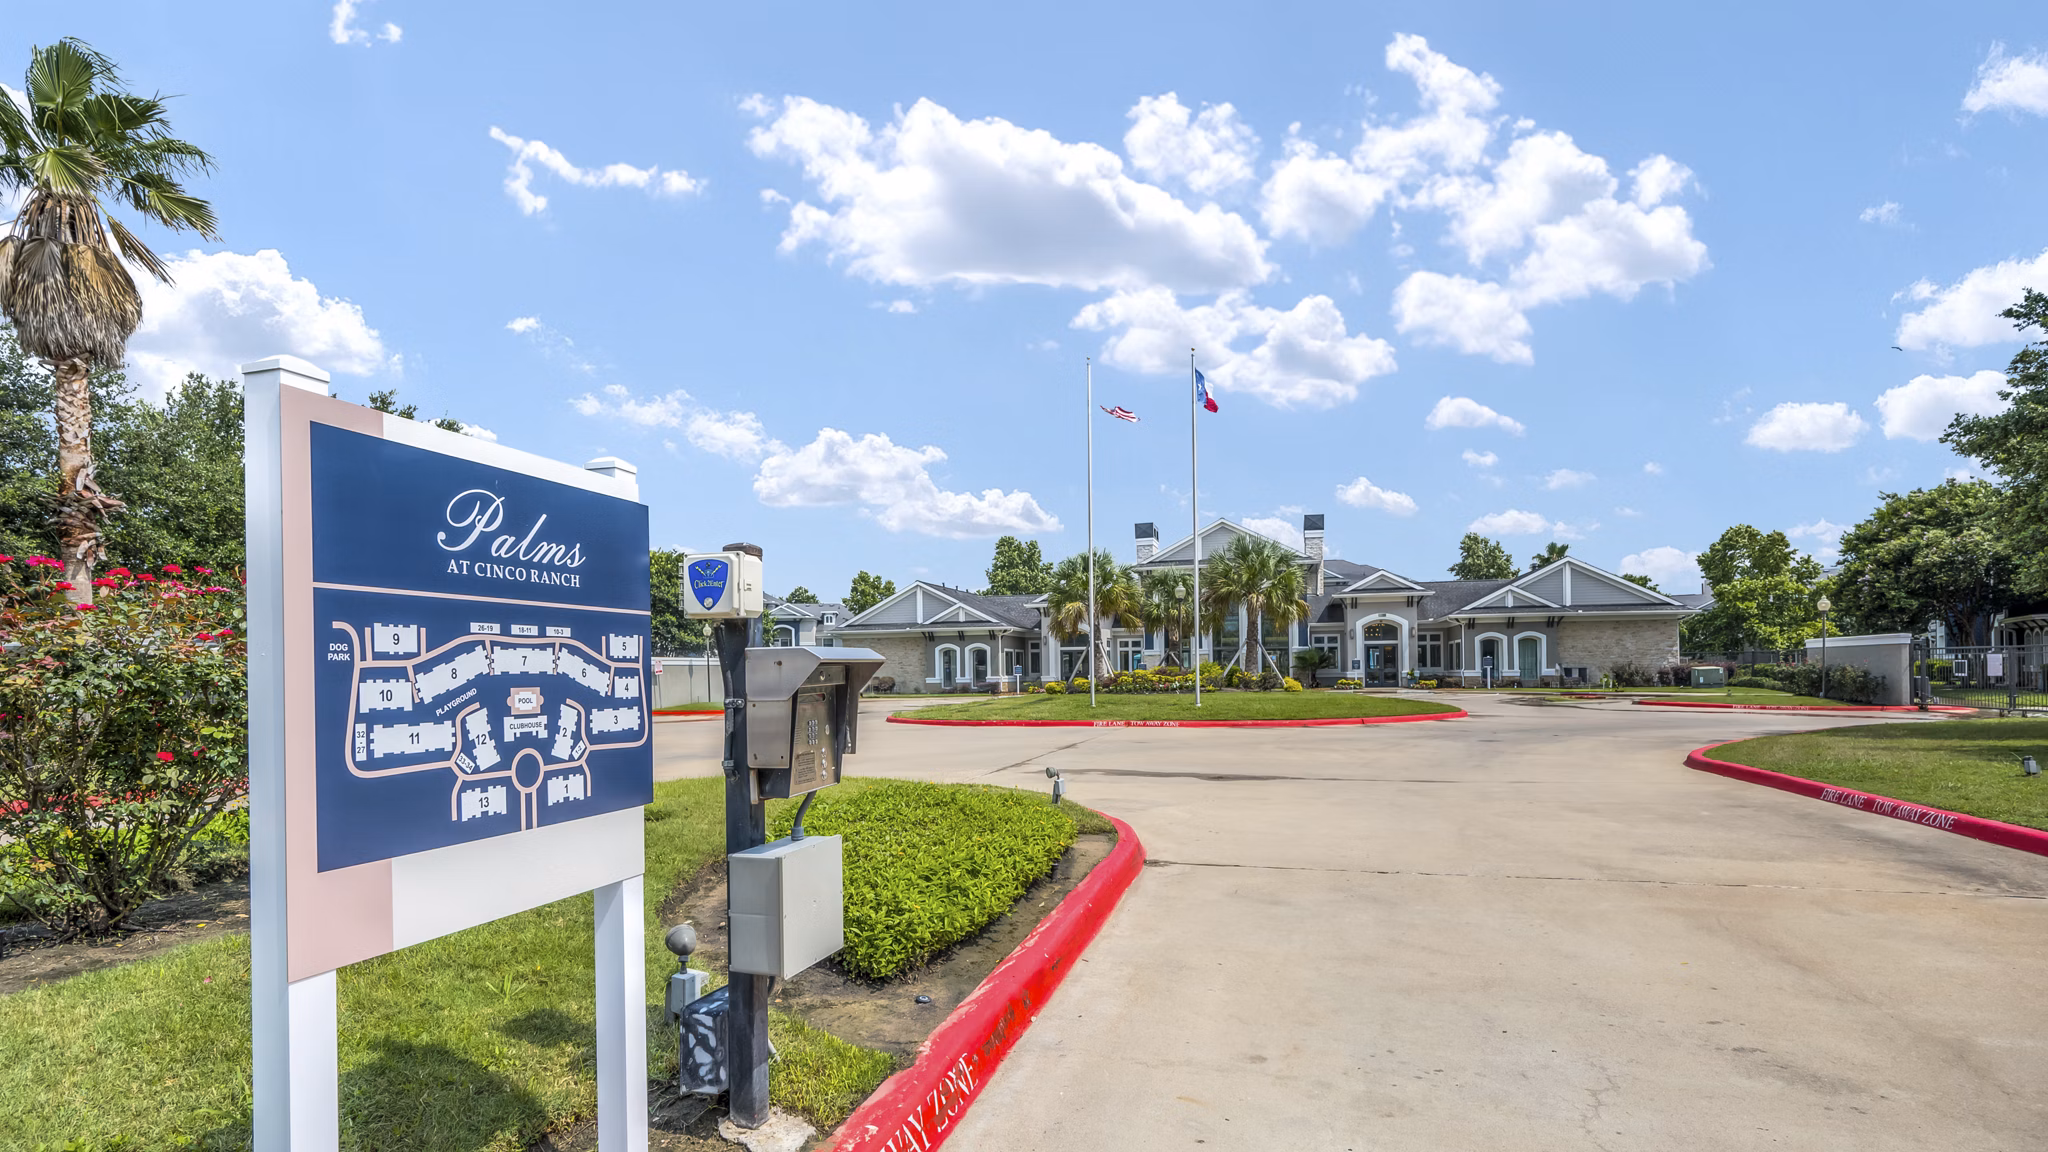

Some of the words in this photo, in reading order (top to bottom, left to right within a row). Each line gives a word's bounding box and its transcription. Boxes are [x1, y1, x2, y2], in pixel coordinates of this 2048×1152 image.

[437, 489, 586, 568] Palms
[447, 559, 470, 575] AT
[474, 562, 526, 581] CINCO
[530, 569, 580, 588] RANCH
[392, 633, 400, 645] 9
[329, 643, 348, 651] DOG
[622, 642, 626, 651] 5
[522, 656, 527, 666] 7
[451, 668, 457, 679] 8
[582, 668, 587, 677] 6
[624, 683, 629, 692] 4
[379, 690, 393, 702] 10
[435, 688, 477, 717] PLAYGROUND
[613, 715, 618, 724] 3
[509, 722, 542, 730] CLUBHOUSE
[562, 727, 568, 737] 2
[409, 732, 420, 744] 11
[475, 734, 487, 746] 12
[564, 784, 568, 794] 1
[478, 797, 490, 808] 13
[1820, 788, 1842, 800] FIRE
[1840, 792, 1867, 808] LANE
[1872, 798, 1897, 814] TOW
[1894, 804, 1925, 821] AWAY
[1922, 811, 1958, 830] ZONE
